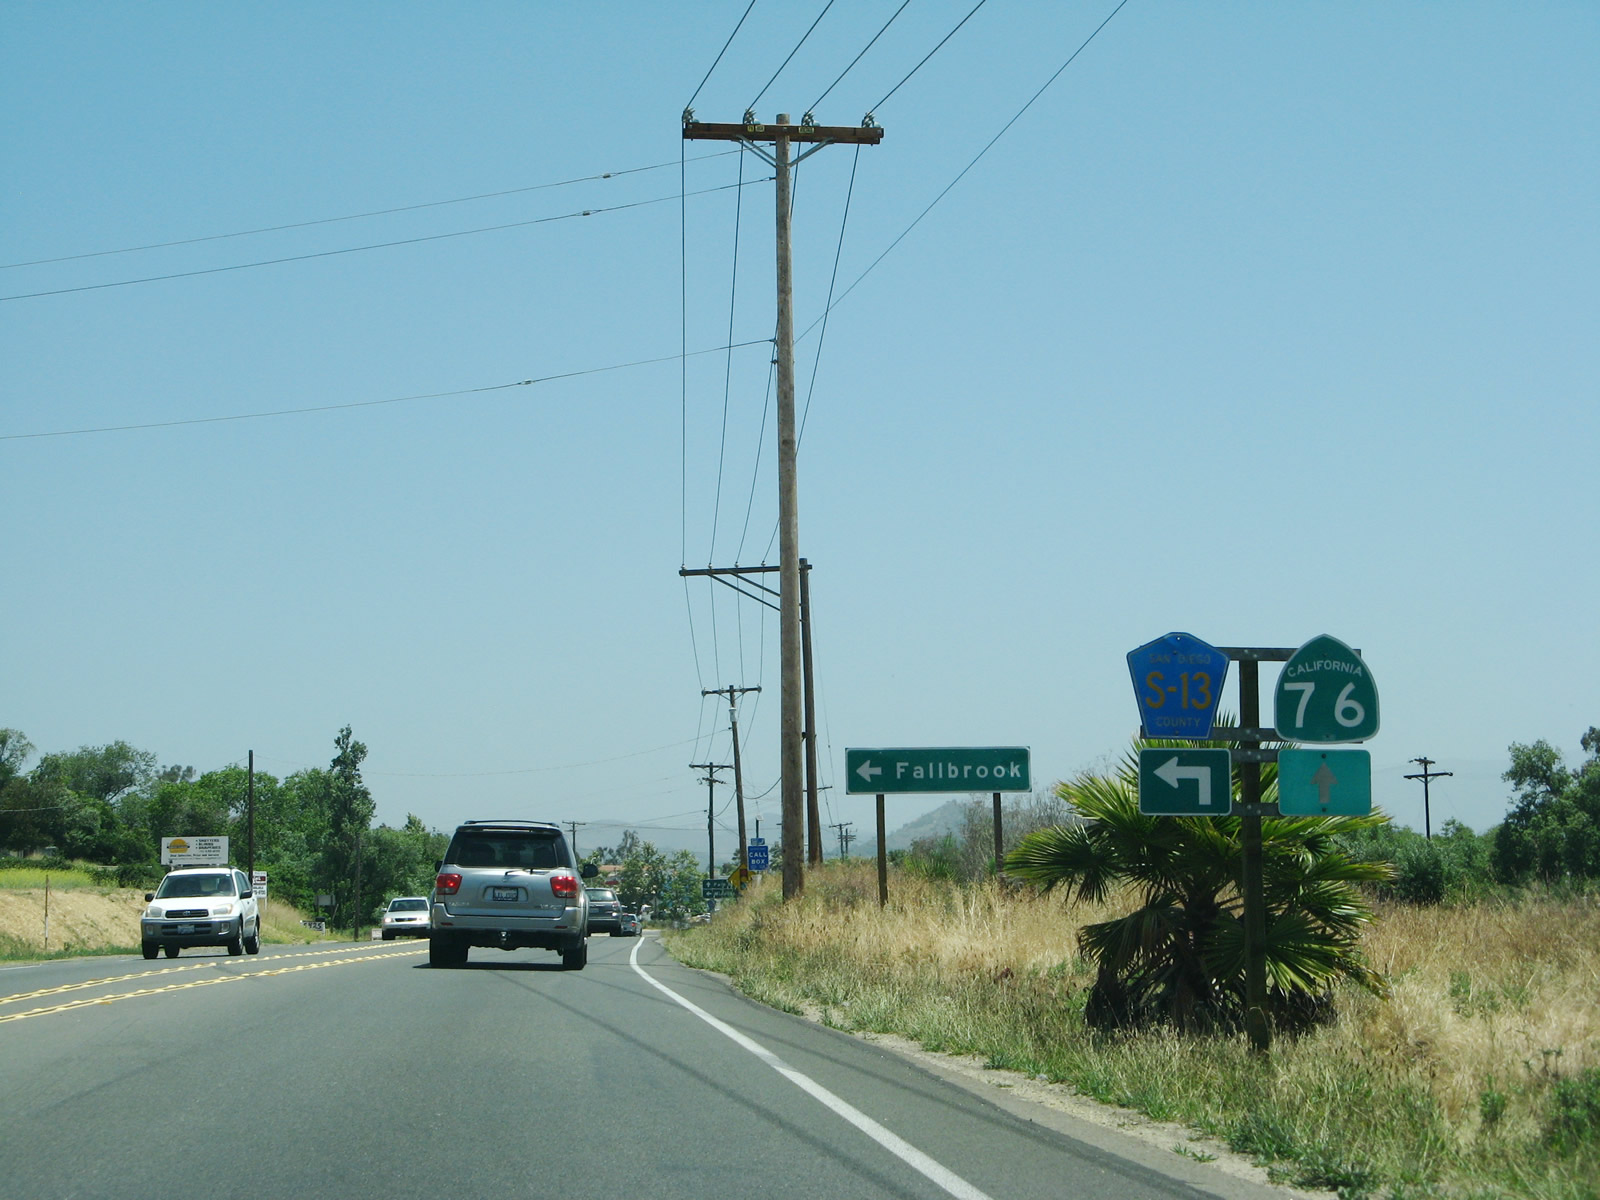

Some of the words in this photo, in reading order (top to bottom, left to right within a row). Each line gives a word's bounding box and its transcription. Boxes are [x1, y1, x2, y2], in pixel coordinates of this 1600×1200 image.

[1148, 653, 1171, 665] SAN
[1178, 653, 1211, 665] DIEGO
[1287, 660, 1363, 677] CALIFORNIA
[1145, 671, 1212, 710] S-13
[1155, 716, 1202, 728] COUNTY
[896, 761, 1022, 779] Fallbrook
